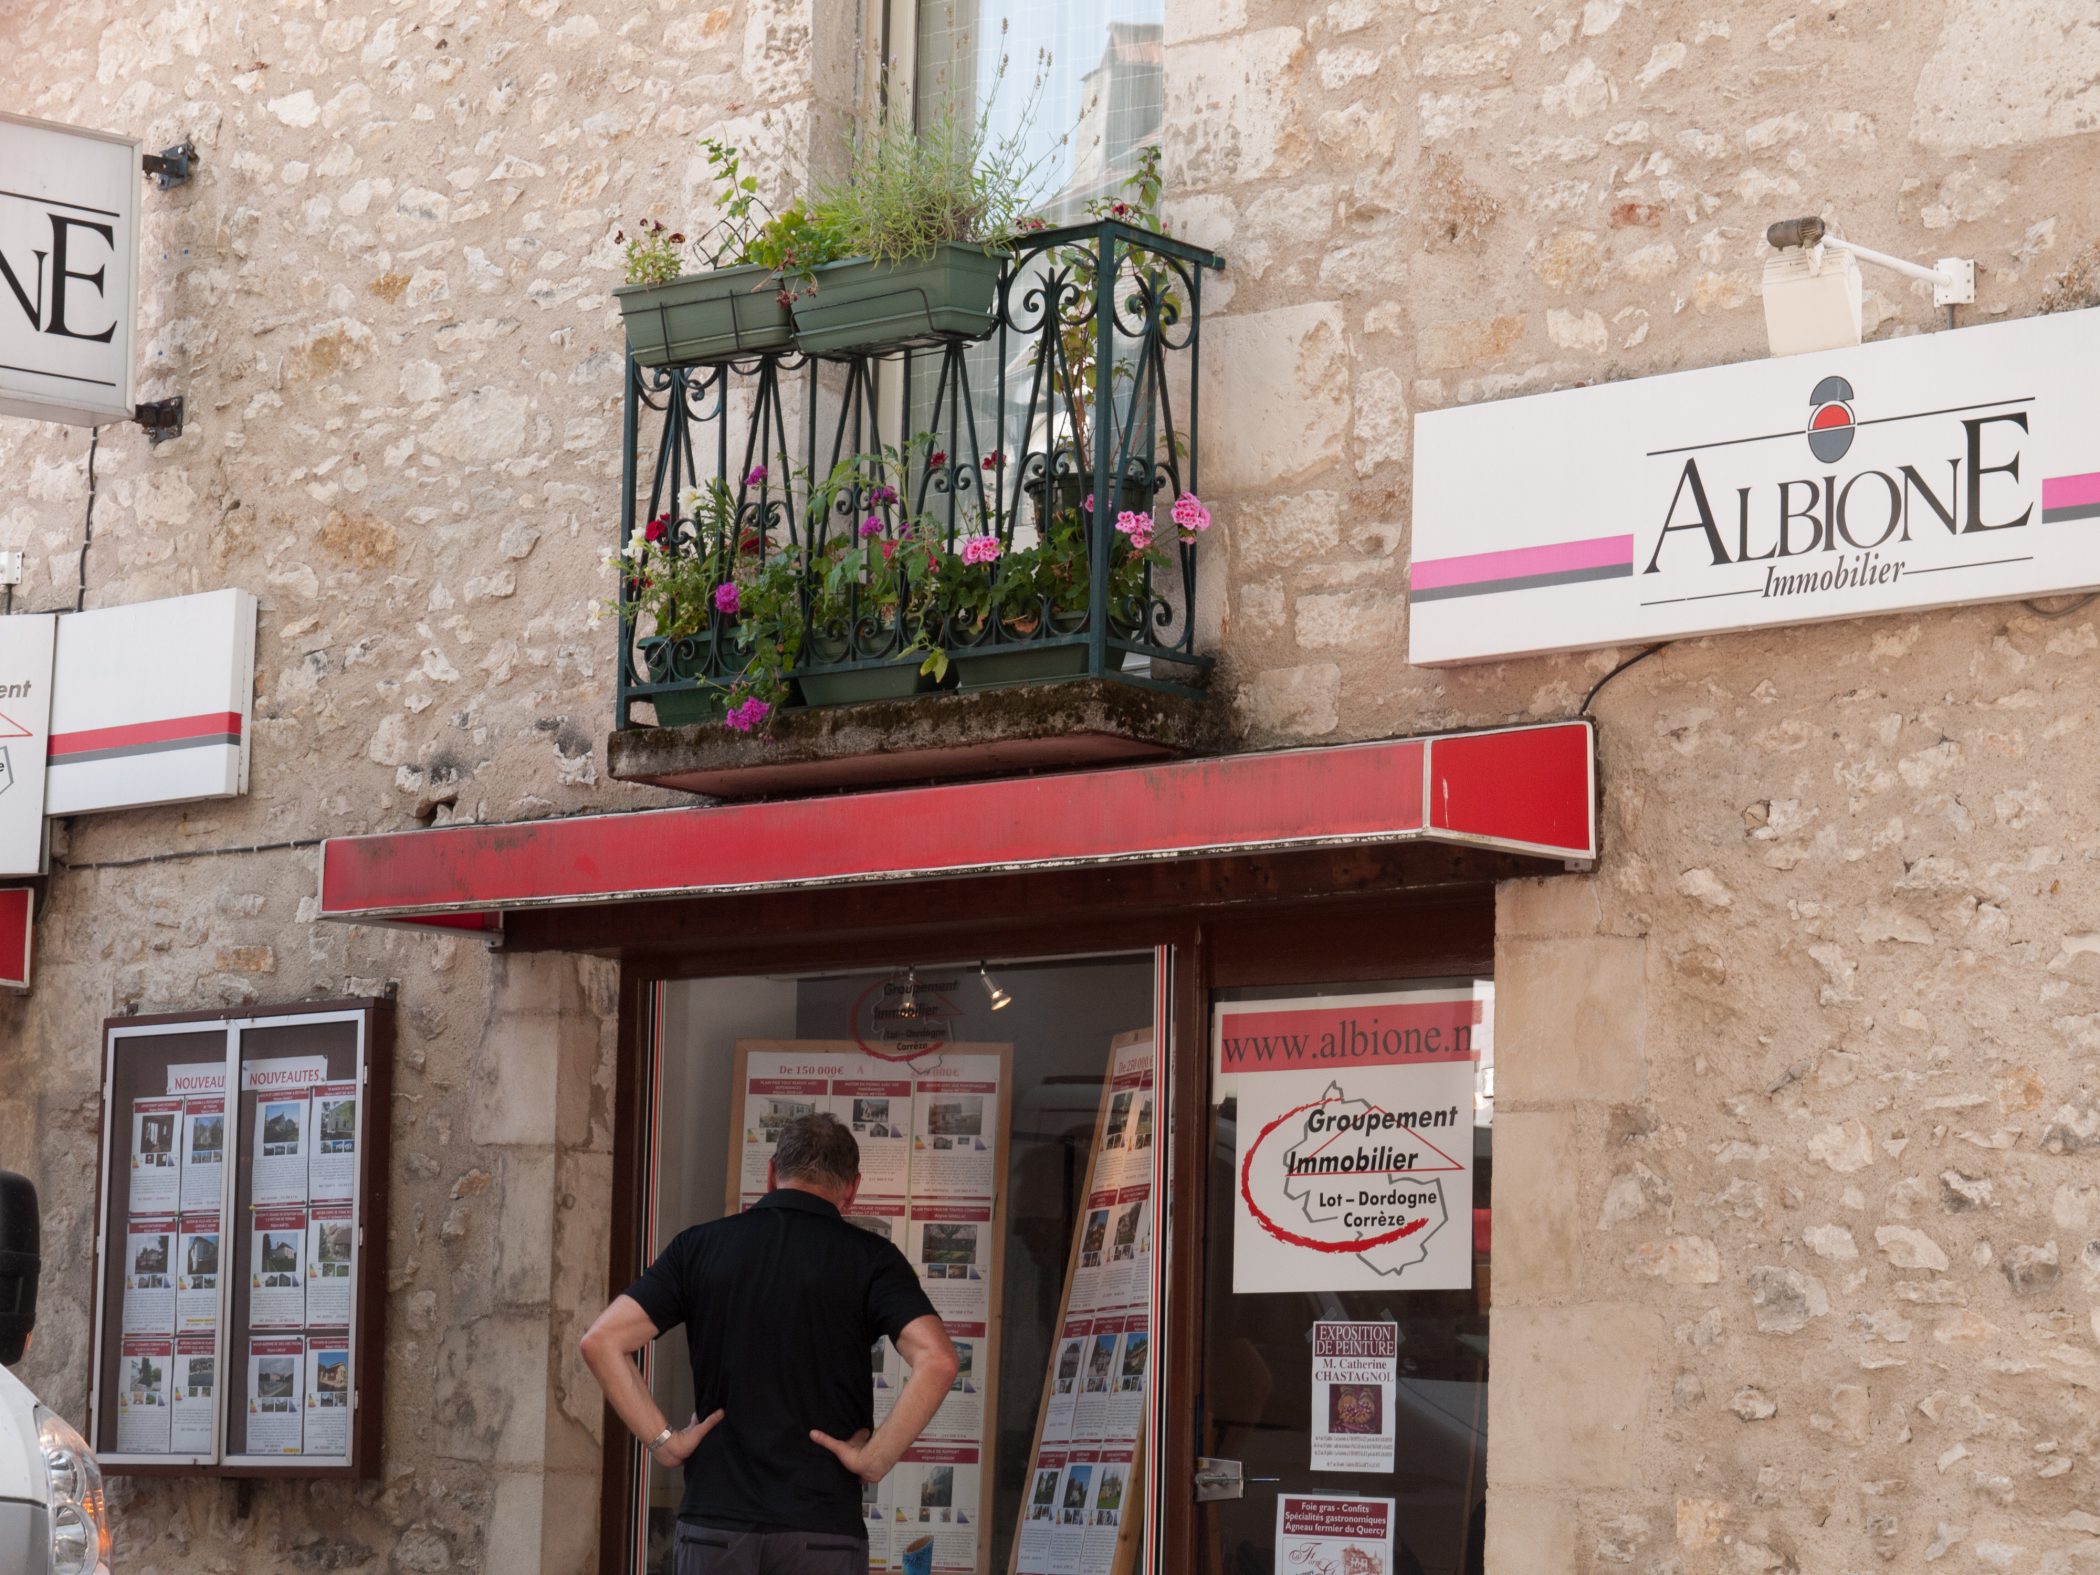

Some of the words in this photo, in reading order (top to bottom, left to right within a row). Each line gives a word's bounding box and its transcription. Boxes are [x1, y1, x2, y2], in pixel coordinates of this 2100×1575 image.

[1643, 411, 2035, 575] ALBIONE
[1761, 553, 1906, 600] Immobilier
[884, 980, 959, 998] Groupement
[874, 1001, 939, 1019] Immobilier
[250, 1069, 320, 1086] NOUVEAUTES
[779, 1065, 793, 1075] De
[797, 1065, 815, 1076] 150
[175, 1075, 225, 1090] NOUVEAU
[1307, 1106, 1459, 1137] Groupement
[1289, 1145, 1419, 1175] Immobilier
[1319, 1192, 1343, 1207] Lot
[1358, 1189, 1438, 1208] Dordogne
[1343, 1210, 1406, 1228] Corrèze
[1320, 1325, 1391, 1341] EXPOSITION
[1316, 1340, 1333, 1355] DE
[1335, 1340, 1395, 1356] PEINTURE
[1322, 1358, 1336, 1369] M.
[1339, 1358, 1387, 1370] Catherine
[1315, 1370, 1394, 1383] CHASTAGNOL
[1301, 1501, 1318, 1512] Foie
[1319, 1503, 1335, 1513] gras
[1341, 1503, 1370, 1514] Confits
[1285, 1511, 1324, 1522] Spécialités
[1325, 1513, 1387, 1526] gastronomiques
[1285, 1521, 1314, 1533] Agneau
[1314, 1523, 1343, 1533] fermier
[1344, 1524, 1355, 1534] du
[1356, 1525, 1385, 1537] Quercy
